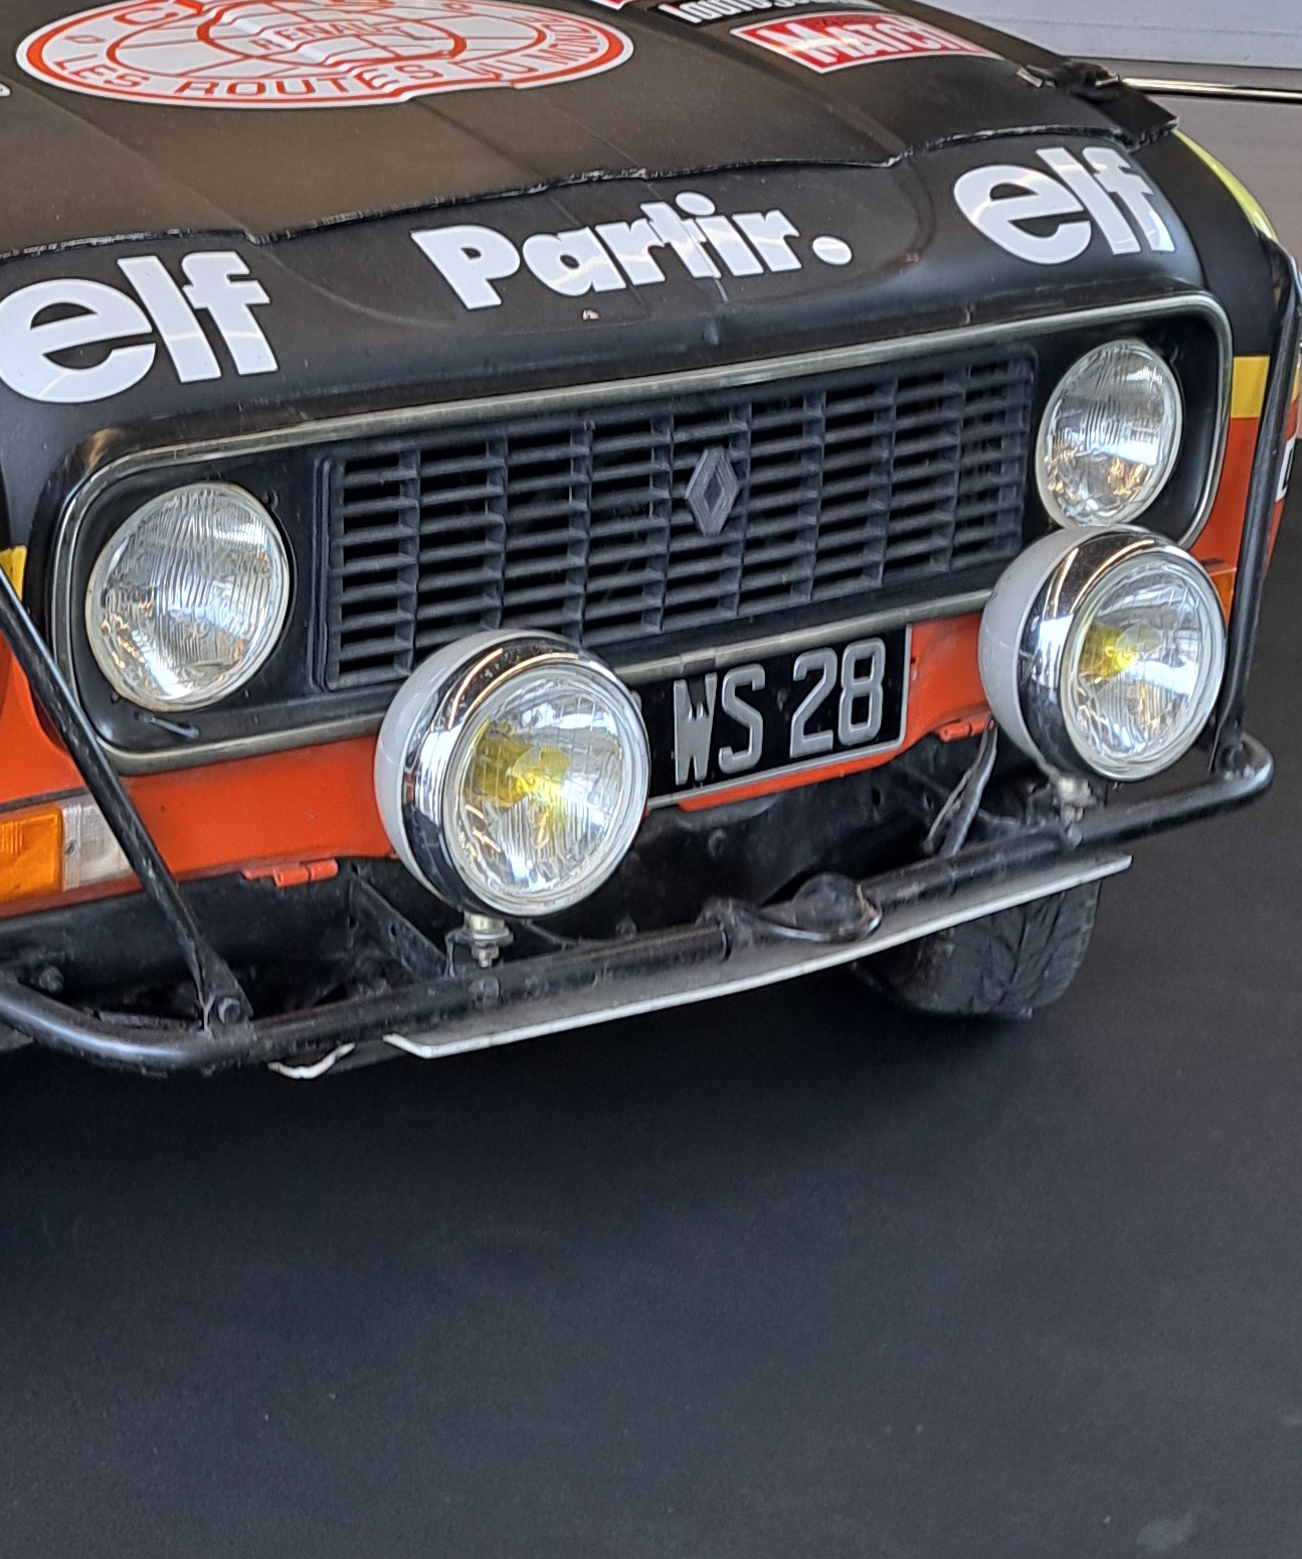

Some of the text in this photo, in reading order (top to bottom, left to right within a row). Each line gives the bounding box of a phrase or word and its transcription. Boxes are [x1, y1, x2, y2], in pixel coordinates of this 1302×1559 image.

[54, 53, 151, 88] LES
[174, 64, 444, 95] ROUTES
[756, 15, 982, 64] MATCH
[412, 192, 853, 309] Partir.
[954, 146, 1177, 265] elf
[672, 637, 886, 786] WS 28
